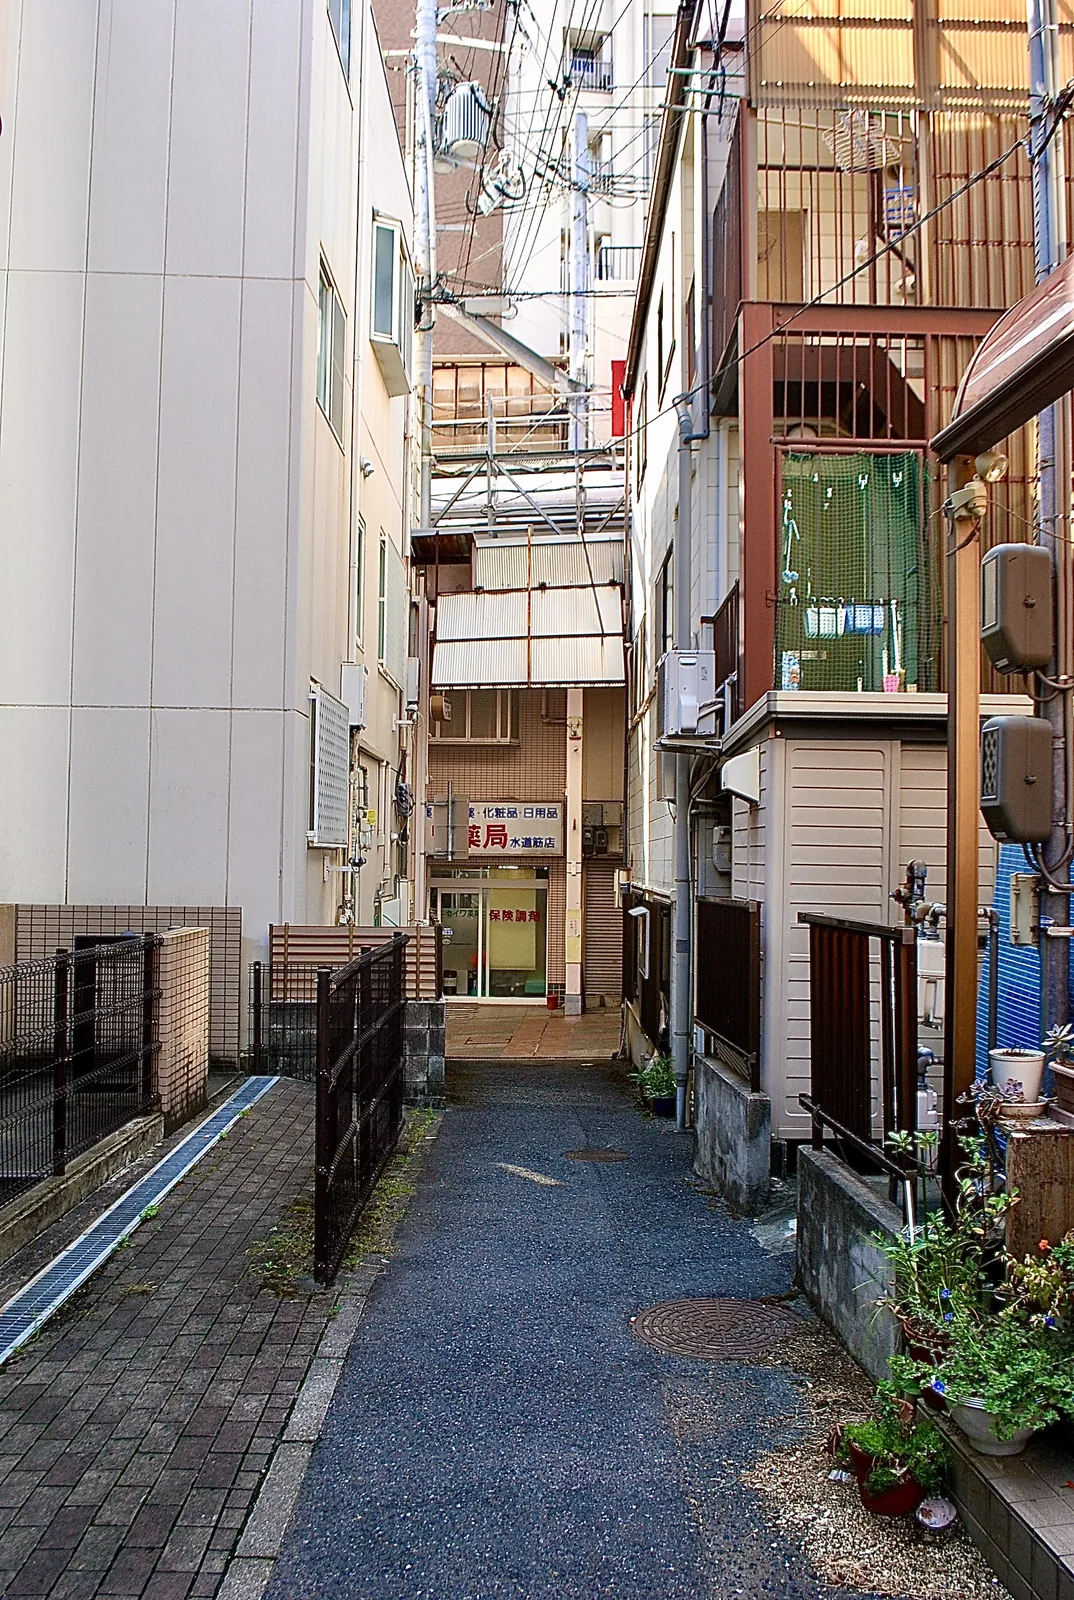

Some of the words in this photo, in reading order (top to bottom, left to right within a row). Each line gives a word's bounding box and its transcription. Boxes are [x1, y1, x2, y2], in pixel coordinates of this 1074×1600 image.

[509, 837, 556, 849] 水道筋店
[489, 909, 541, 922] 保険調剤
